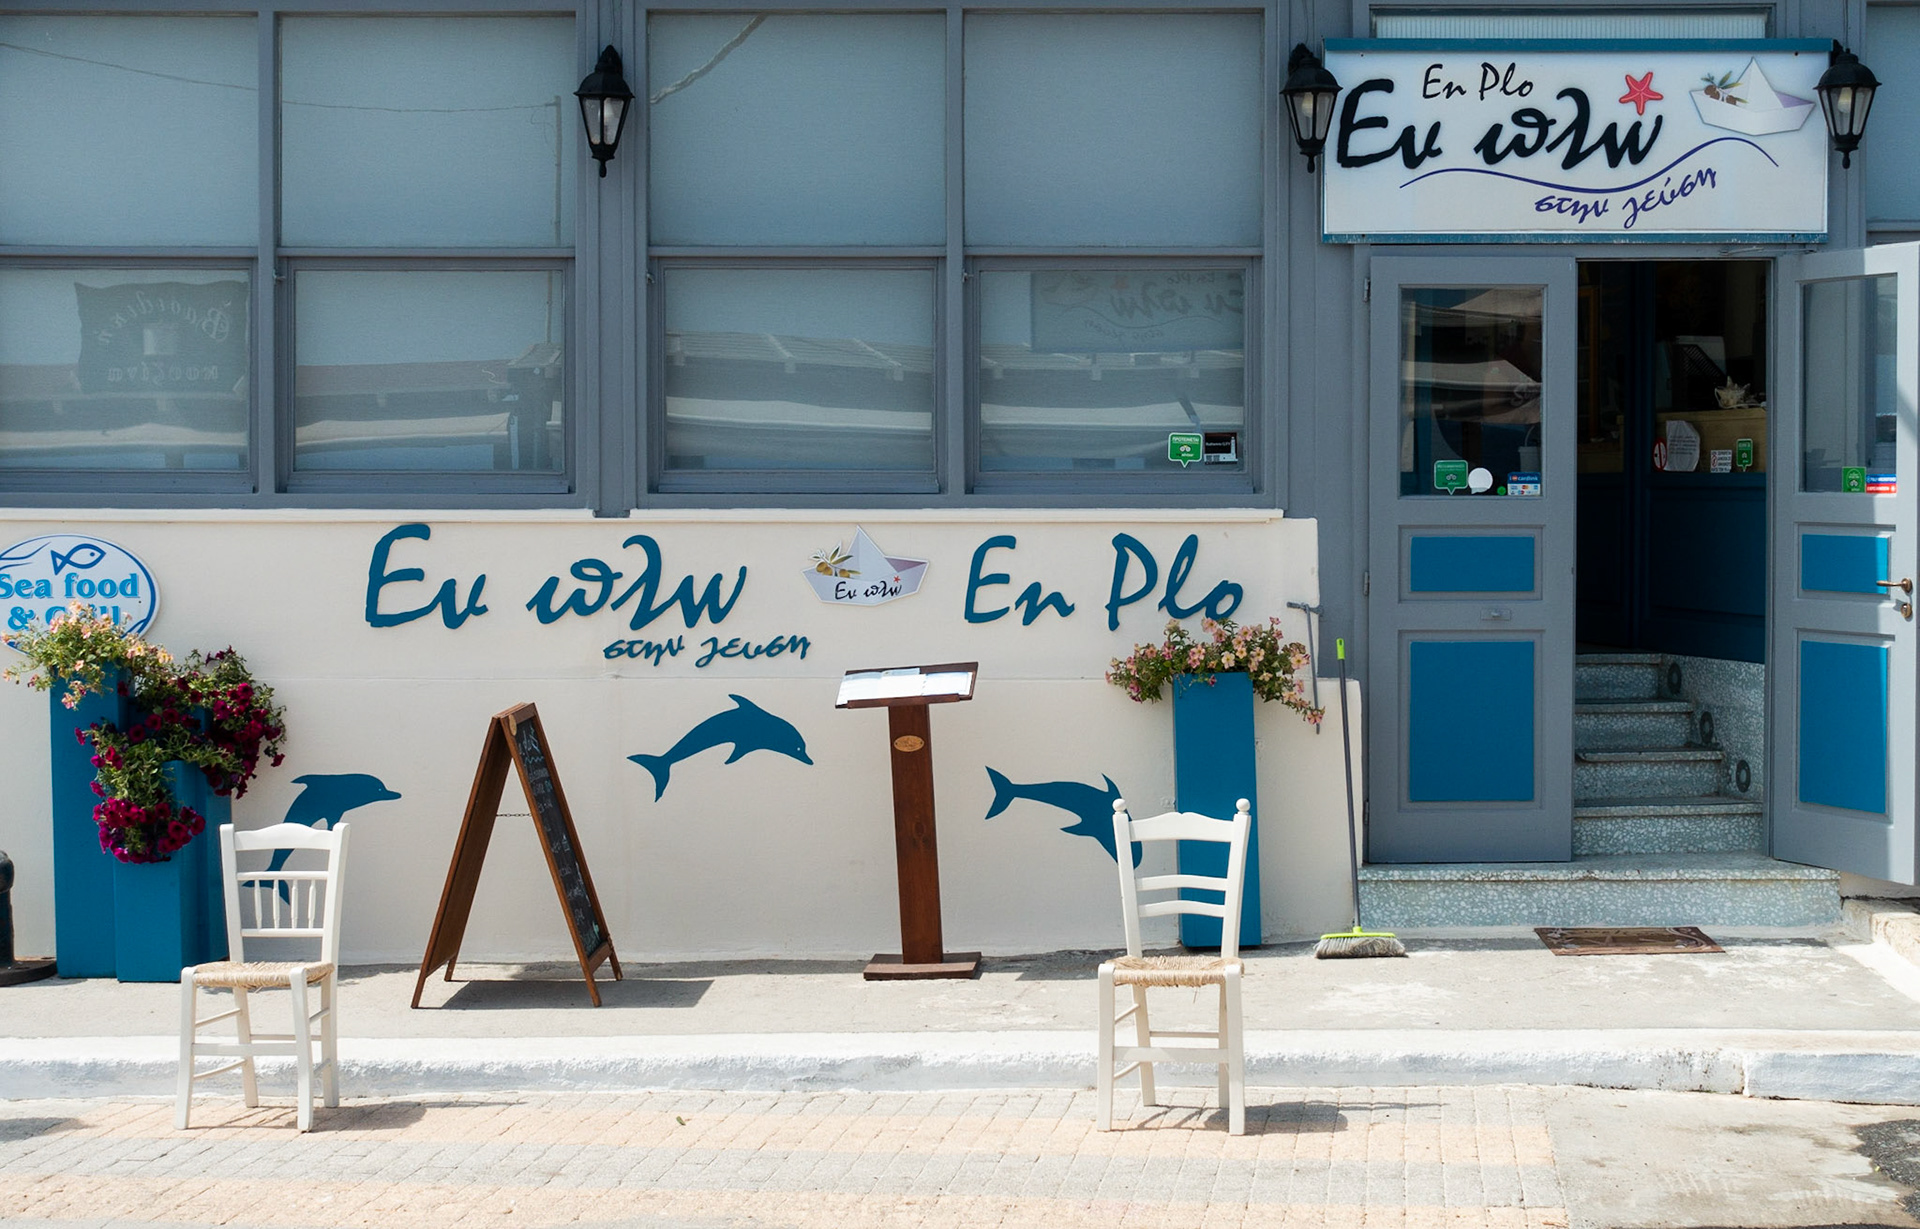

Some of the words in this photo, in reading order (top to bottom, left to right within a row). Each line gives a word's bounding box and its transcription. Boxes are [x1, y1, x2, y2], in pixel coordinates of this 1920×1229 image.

[1422, 63, 1467, 100] En
[1478, 61, 1534, 101] Plo
[1337, 77, 1443, 170] Εν
[1534, 195, 1609, 224] στην
[0, 573, 53, 599] Sea
[64, 572, 140, 599] food
[364, 523, 489, 630] Εν
[963, 534, 1076, 627] En
[1104, 532, 1244, 632] Plo
[7, 606, 36, 631] &
[602, 635, 686, 667] στην
